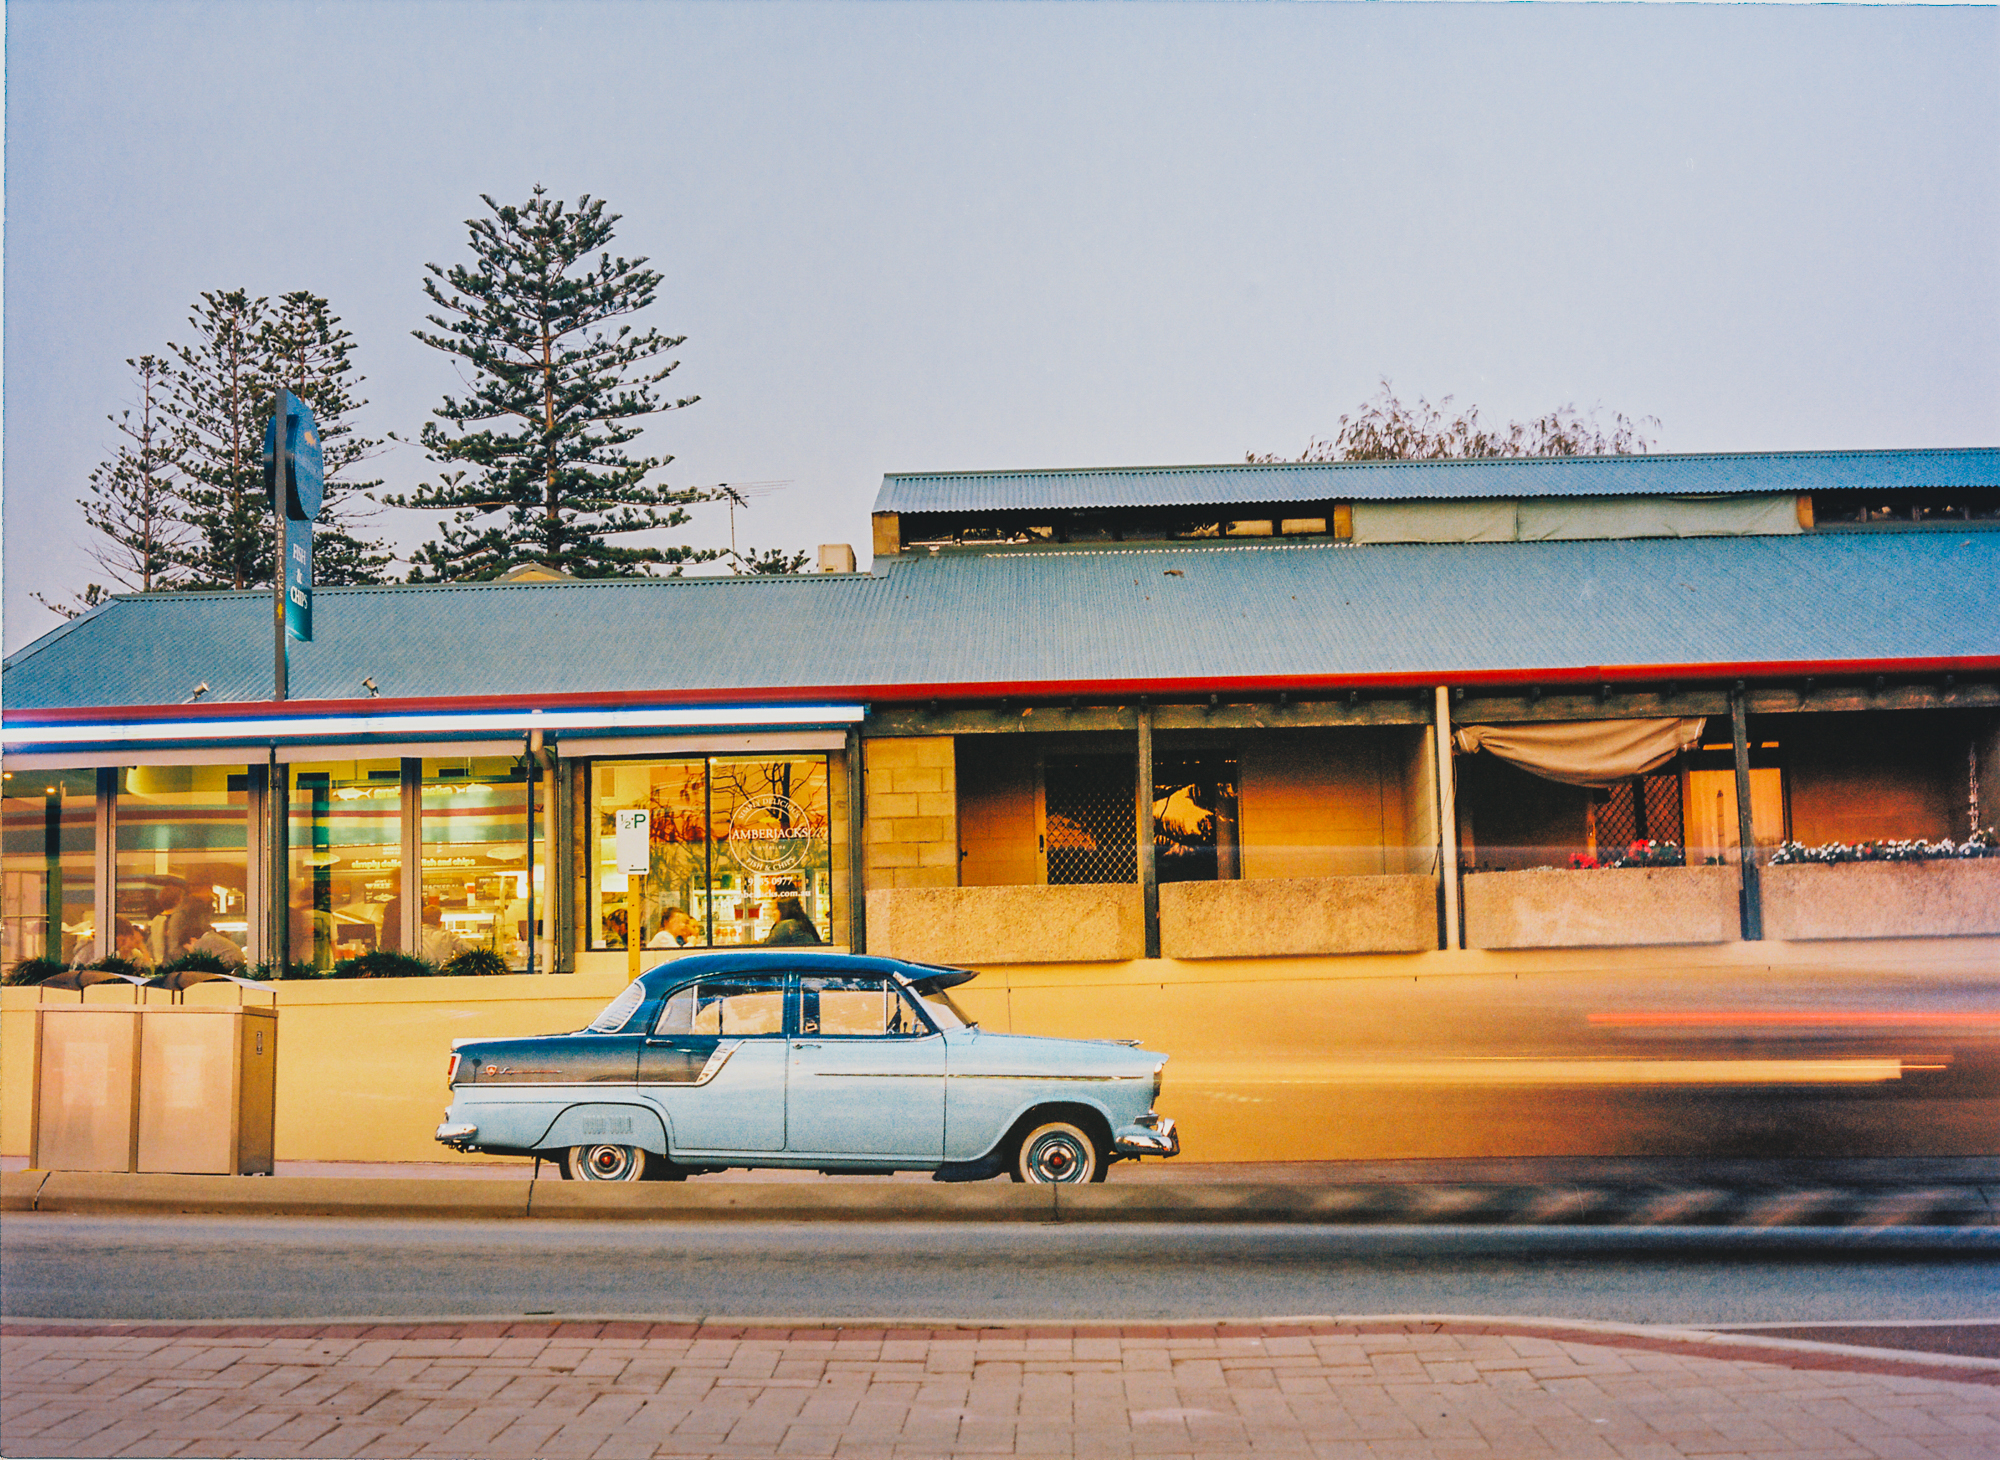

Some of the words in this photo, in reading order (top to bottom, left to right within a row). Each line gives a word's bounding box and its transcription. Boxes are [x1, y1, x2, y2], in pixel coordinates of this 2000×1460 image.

[276, 513, 285, 599] AMBERJACKS
[293, 543, 306, 565] FISH
[296, 568, 303, 584] &
[290, 585, 308, 609] CHIPS
[738, 800, 761, 820] SIMPLY
[762, 798, 801, 819] DELICIOUS
[731, 827, 808, 841] AMBERJACKS
[745, 857, 763, 870] FISH
[772, 857, 795, 871] CHIPS
